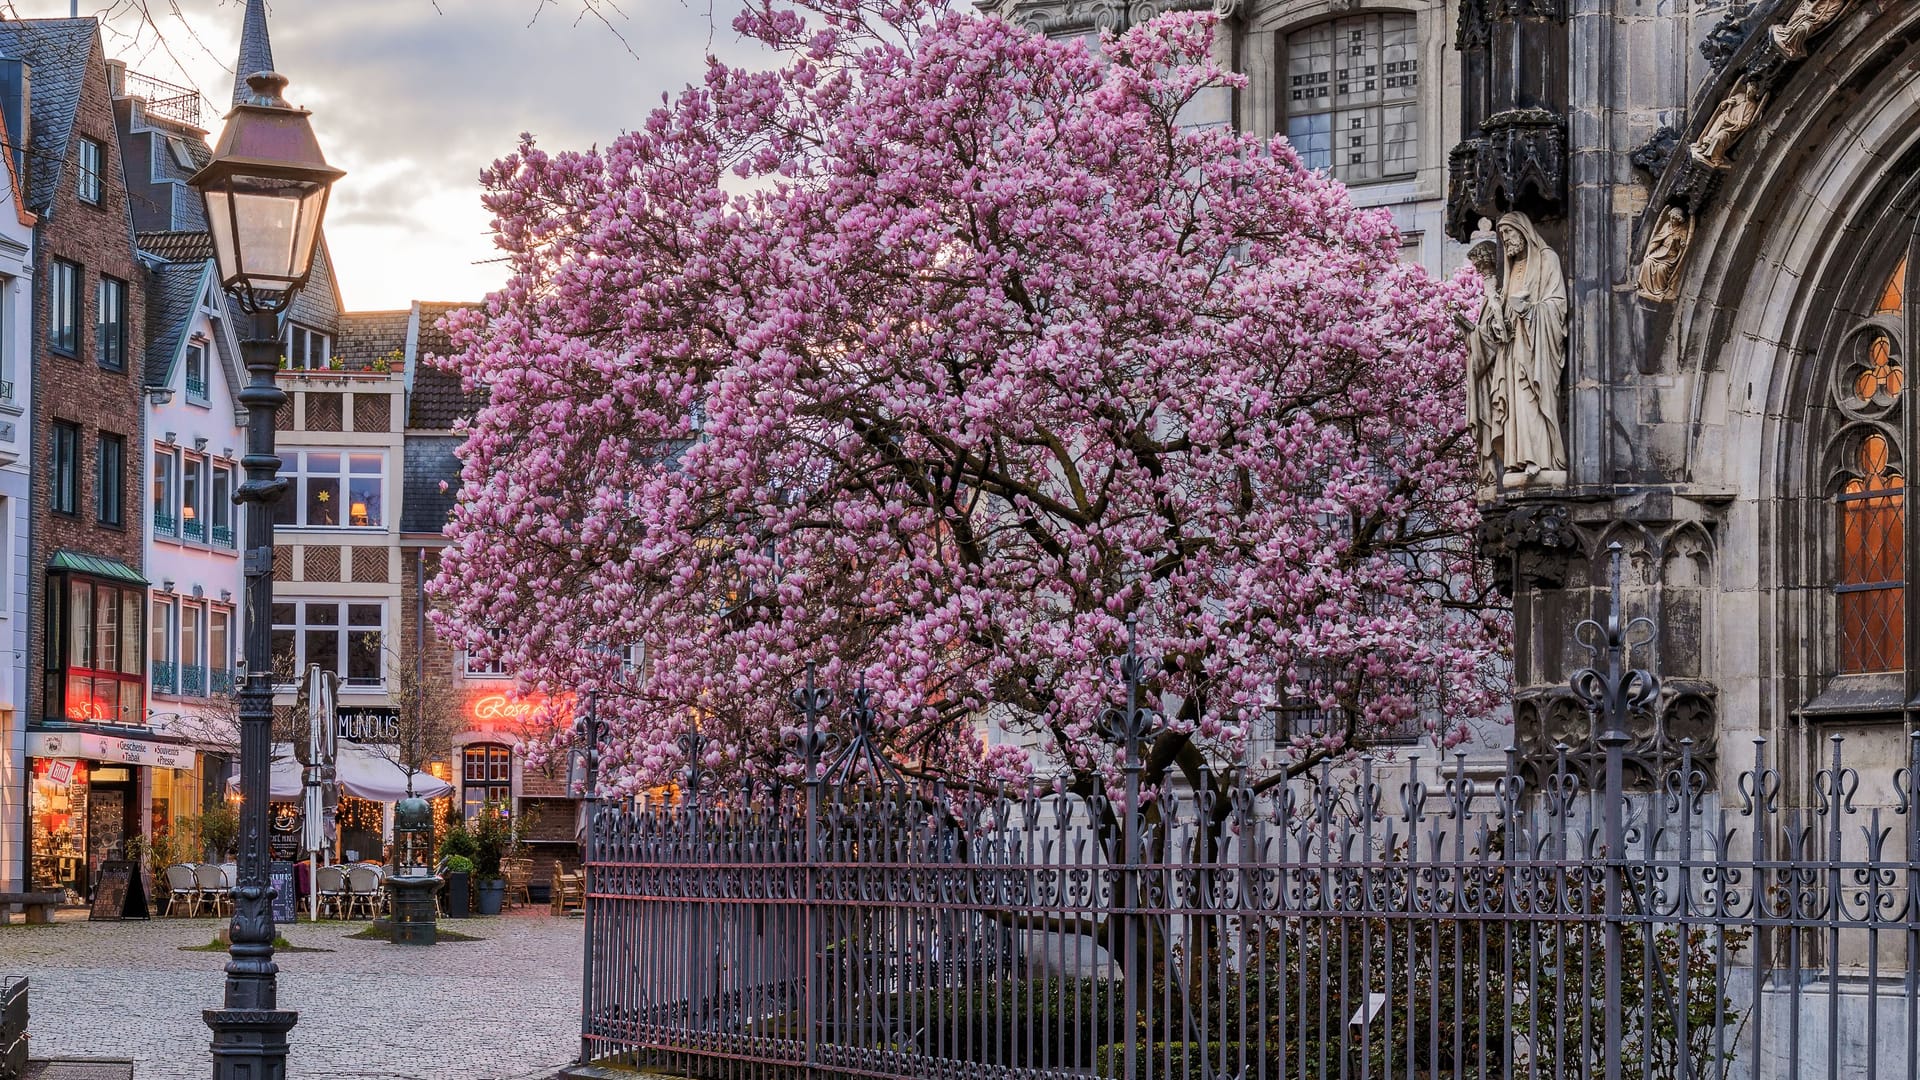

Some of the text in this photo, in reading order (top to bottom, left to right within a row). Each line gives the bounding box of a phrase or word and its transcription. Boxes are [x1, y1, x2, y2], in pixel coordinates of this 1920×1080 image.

[475, 696, 530, 719] Rose
[338, 714, 399, 738] MUNDUS
[120, 741, 147, 753] Geschenke
[157, 745, 179, 756] Souvenirs
[125, 752, 140, 762] Tabak
[159, 757, 175, 766] Presse
